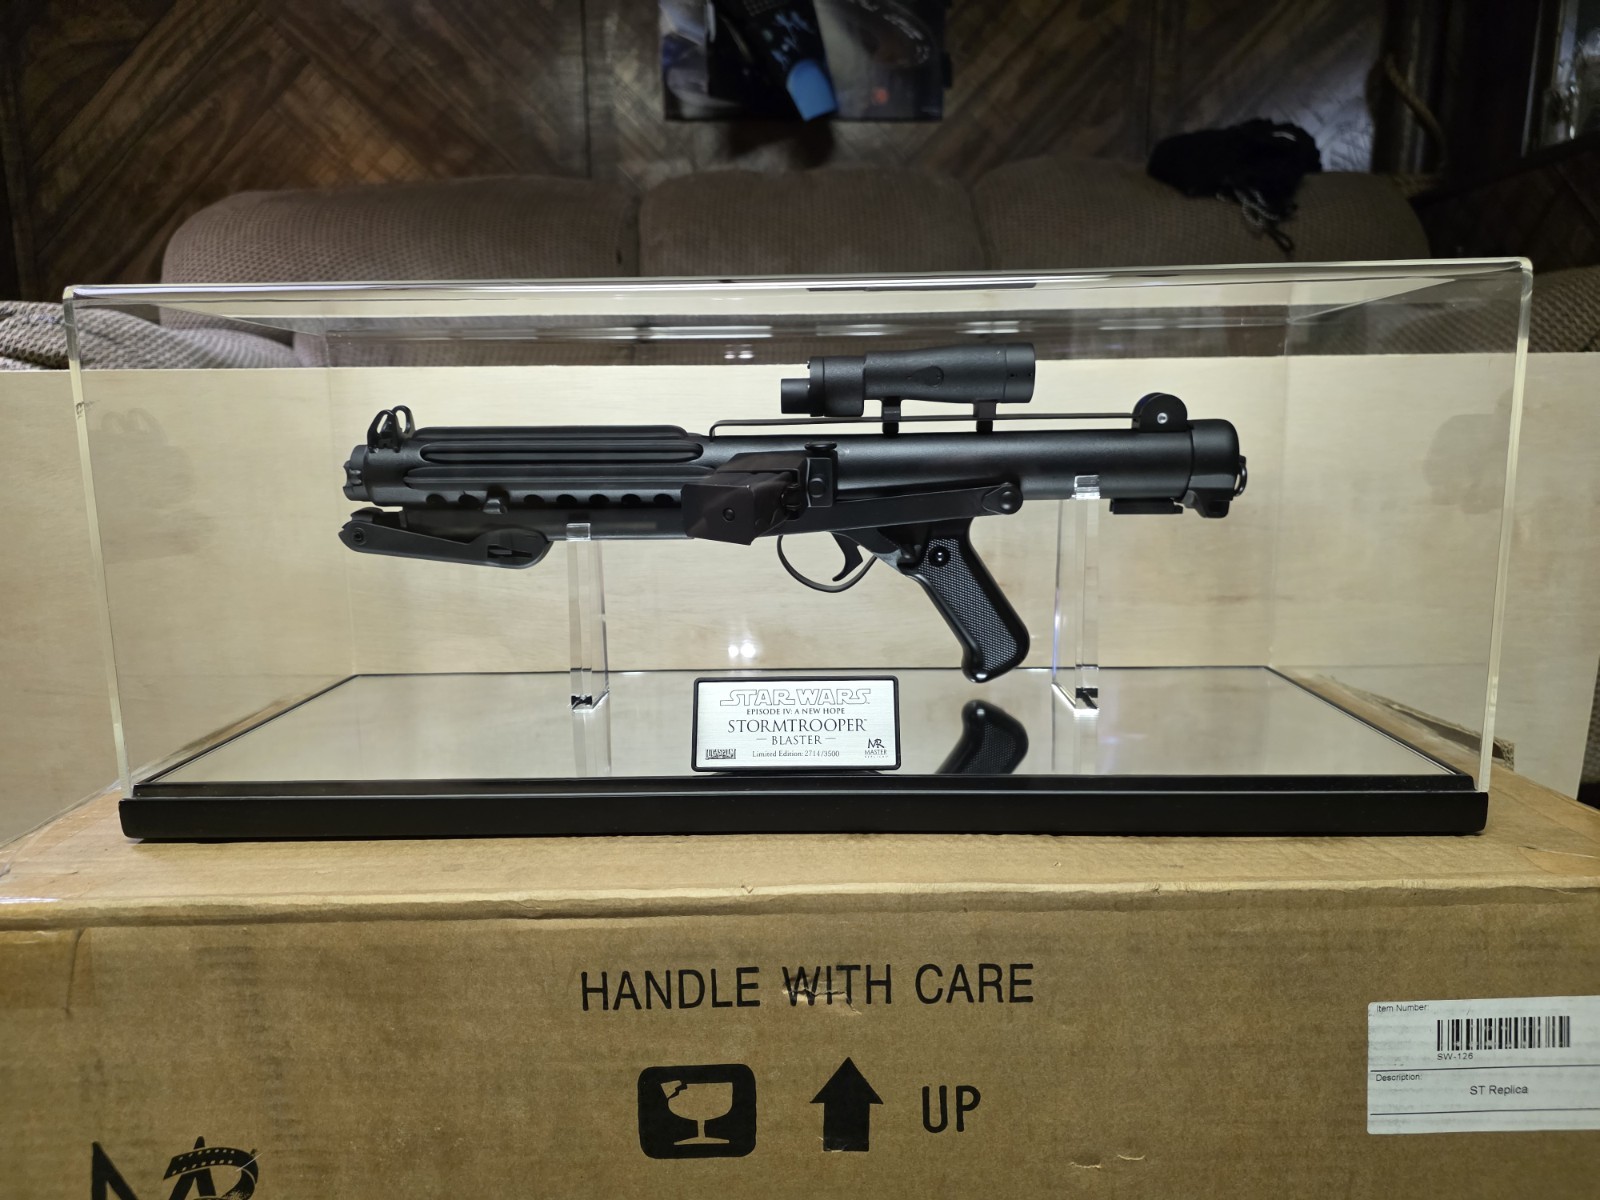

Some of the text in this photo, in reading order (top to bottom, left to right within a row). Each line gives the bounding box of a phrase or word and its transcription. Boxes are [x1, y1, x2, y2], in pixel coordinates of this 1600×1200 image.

[719, 688, 872, 707] STAR WARS
[746, 708, 781, 716] EPISODE
[801, 707, 821, 715] NEW
[823, 707, 845, 715] HOPE
[727, 718, 867, 734] STORMTROOPER
[771, 735, 823, 746] BLASTER
[752, 749, 840, 758] Limited Edition: 2714/3500
[580, 963, 1034, 1012] HANDLE WITH CARE
[1376, 1003, 1430, 1013] Item Number:
[1437, 1052, 1474, 1061] SW-126
[1375, 1073, 1423, 1083] Description:
[1469, 1084, 1529, 1097] ST Replica
[921, 1085, 981, 1133] UP
